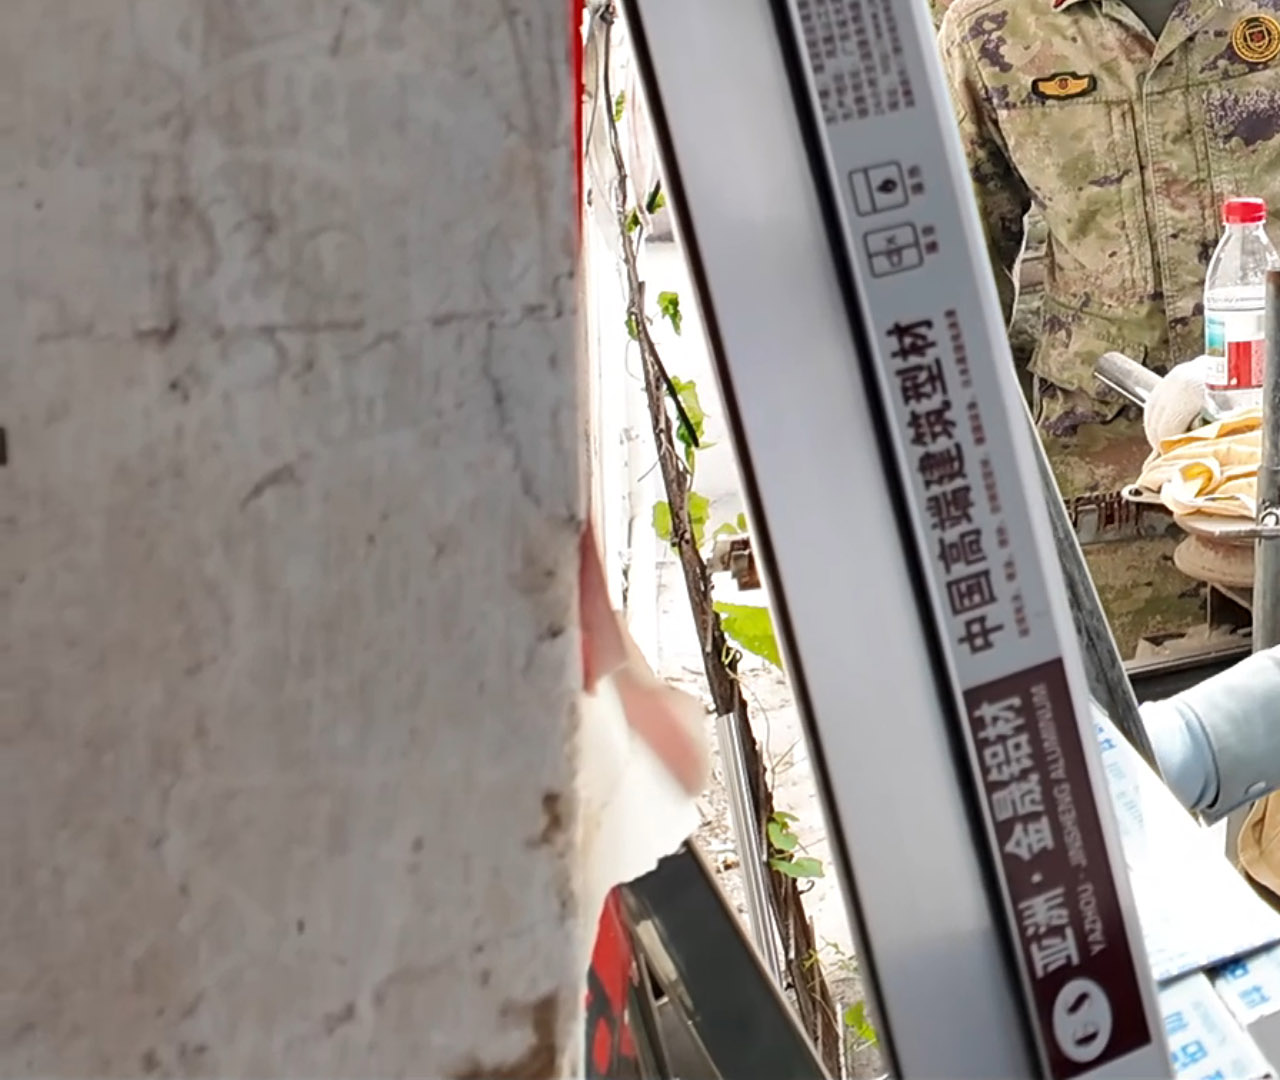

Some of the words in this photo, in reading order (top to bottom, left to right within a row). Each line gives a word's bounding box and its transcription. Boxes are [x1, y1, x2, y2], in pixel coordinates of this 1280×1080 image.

[886, 318, 1005, 655] 中国高端建筑型材
[1029, 681, 1068, 780] ALUMINUM
[1052, 782, 1088, 868] JINSHENG
[1076, 881, 1107, 957] YAZHOU
